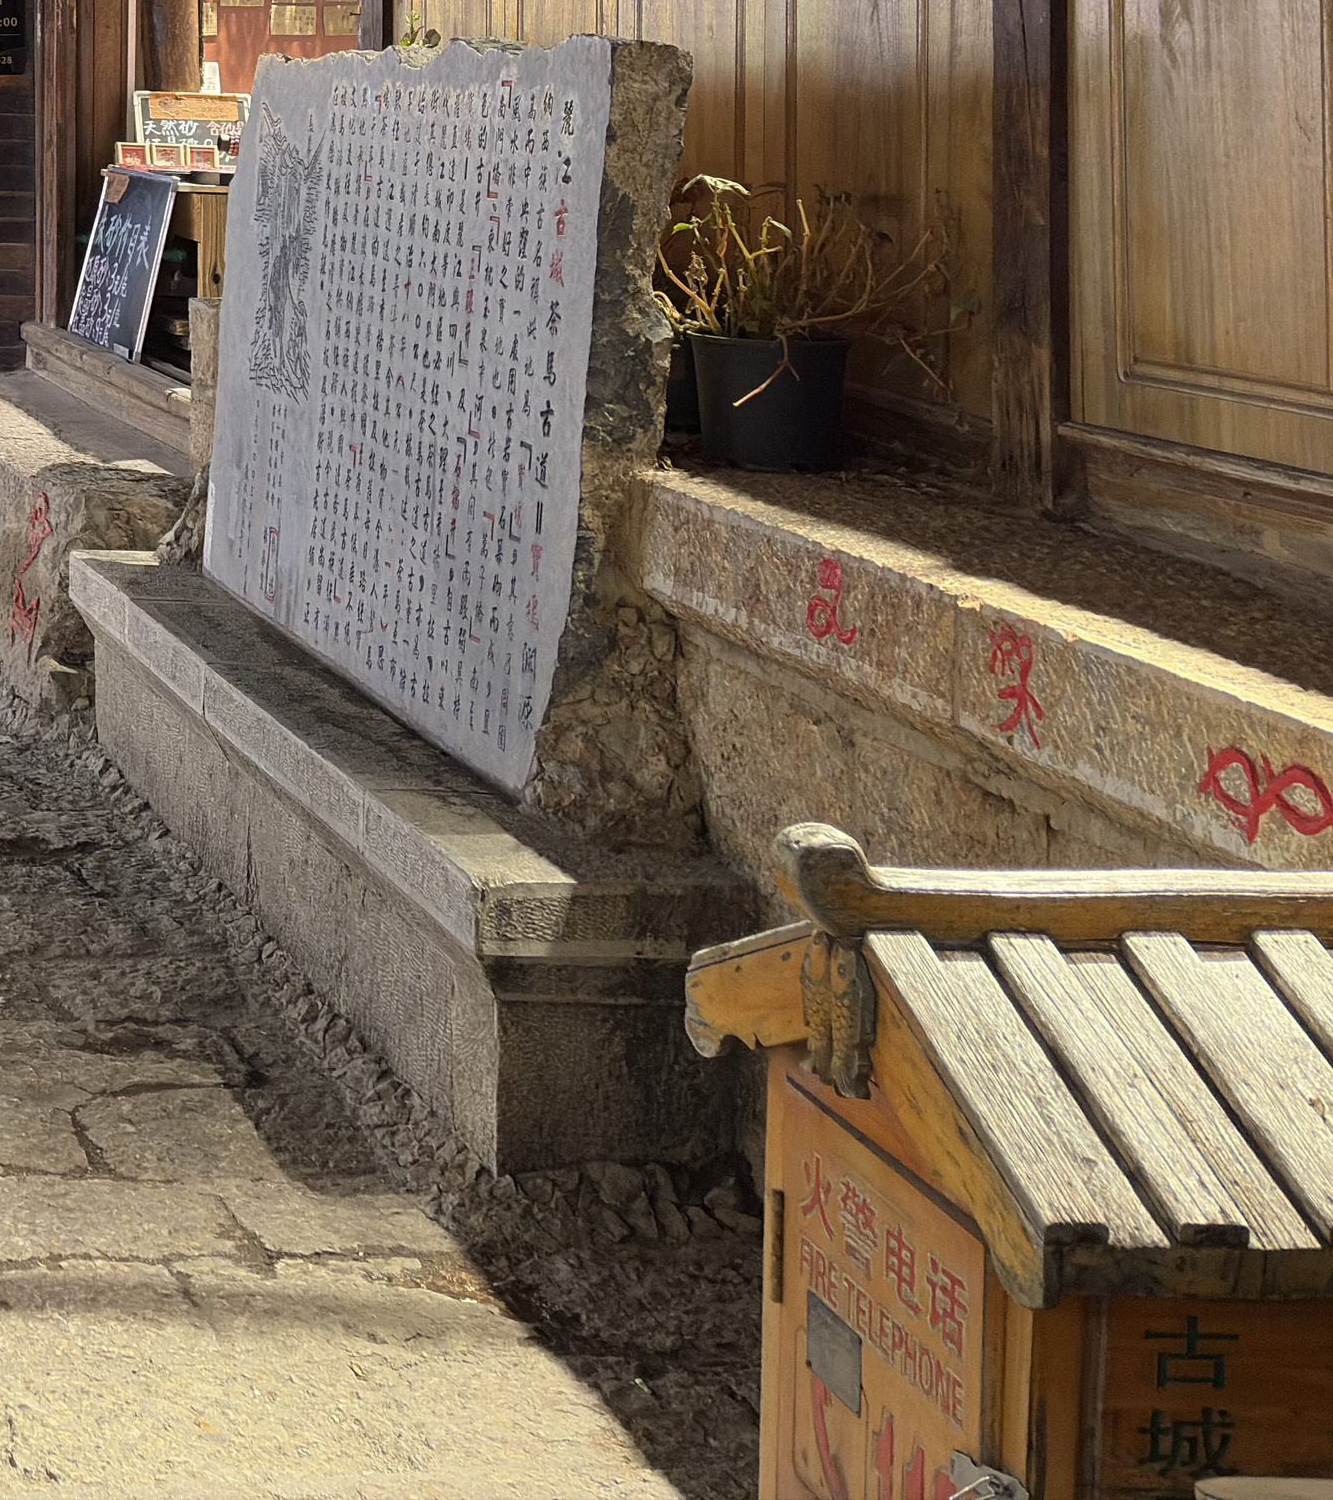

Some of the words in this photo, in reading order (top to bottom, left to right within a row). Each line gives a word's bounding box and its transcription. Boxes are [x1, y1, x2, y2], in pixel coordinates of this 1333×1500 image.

[143, 120, 198, 137] 天然砂
[799, 1150, 970, 1360] 火警电话
[799, 1232, 839, 1310] FIRE
[842, 1275, 966, 1434] TELEPHONE
[1138, 1316, 1240, 1479] 古城
